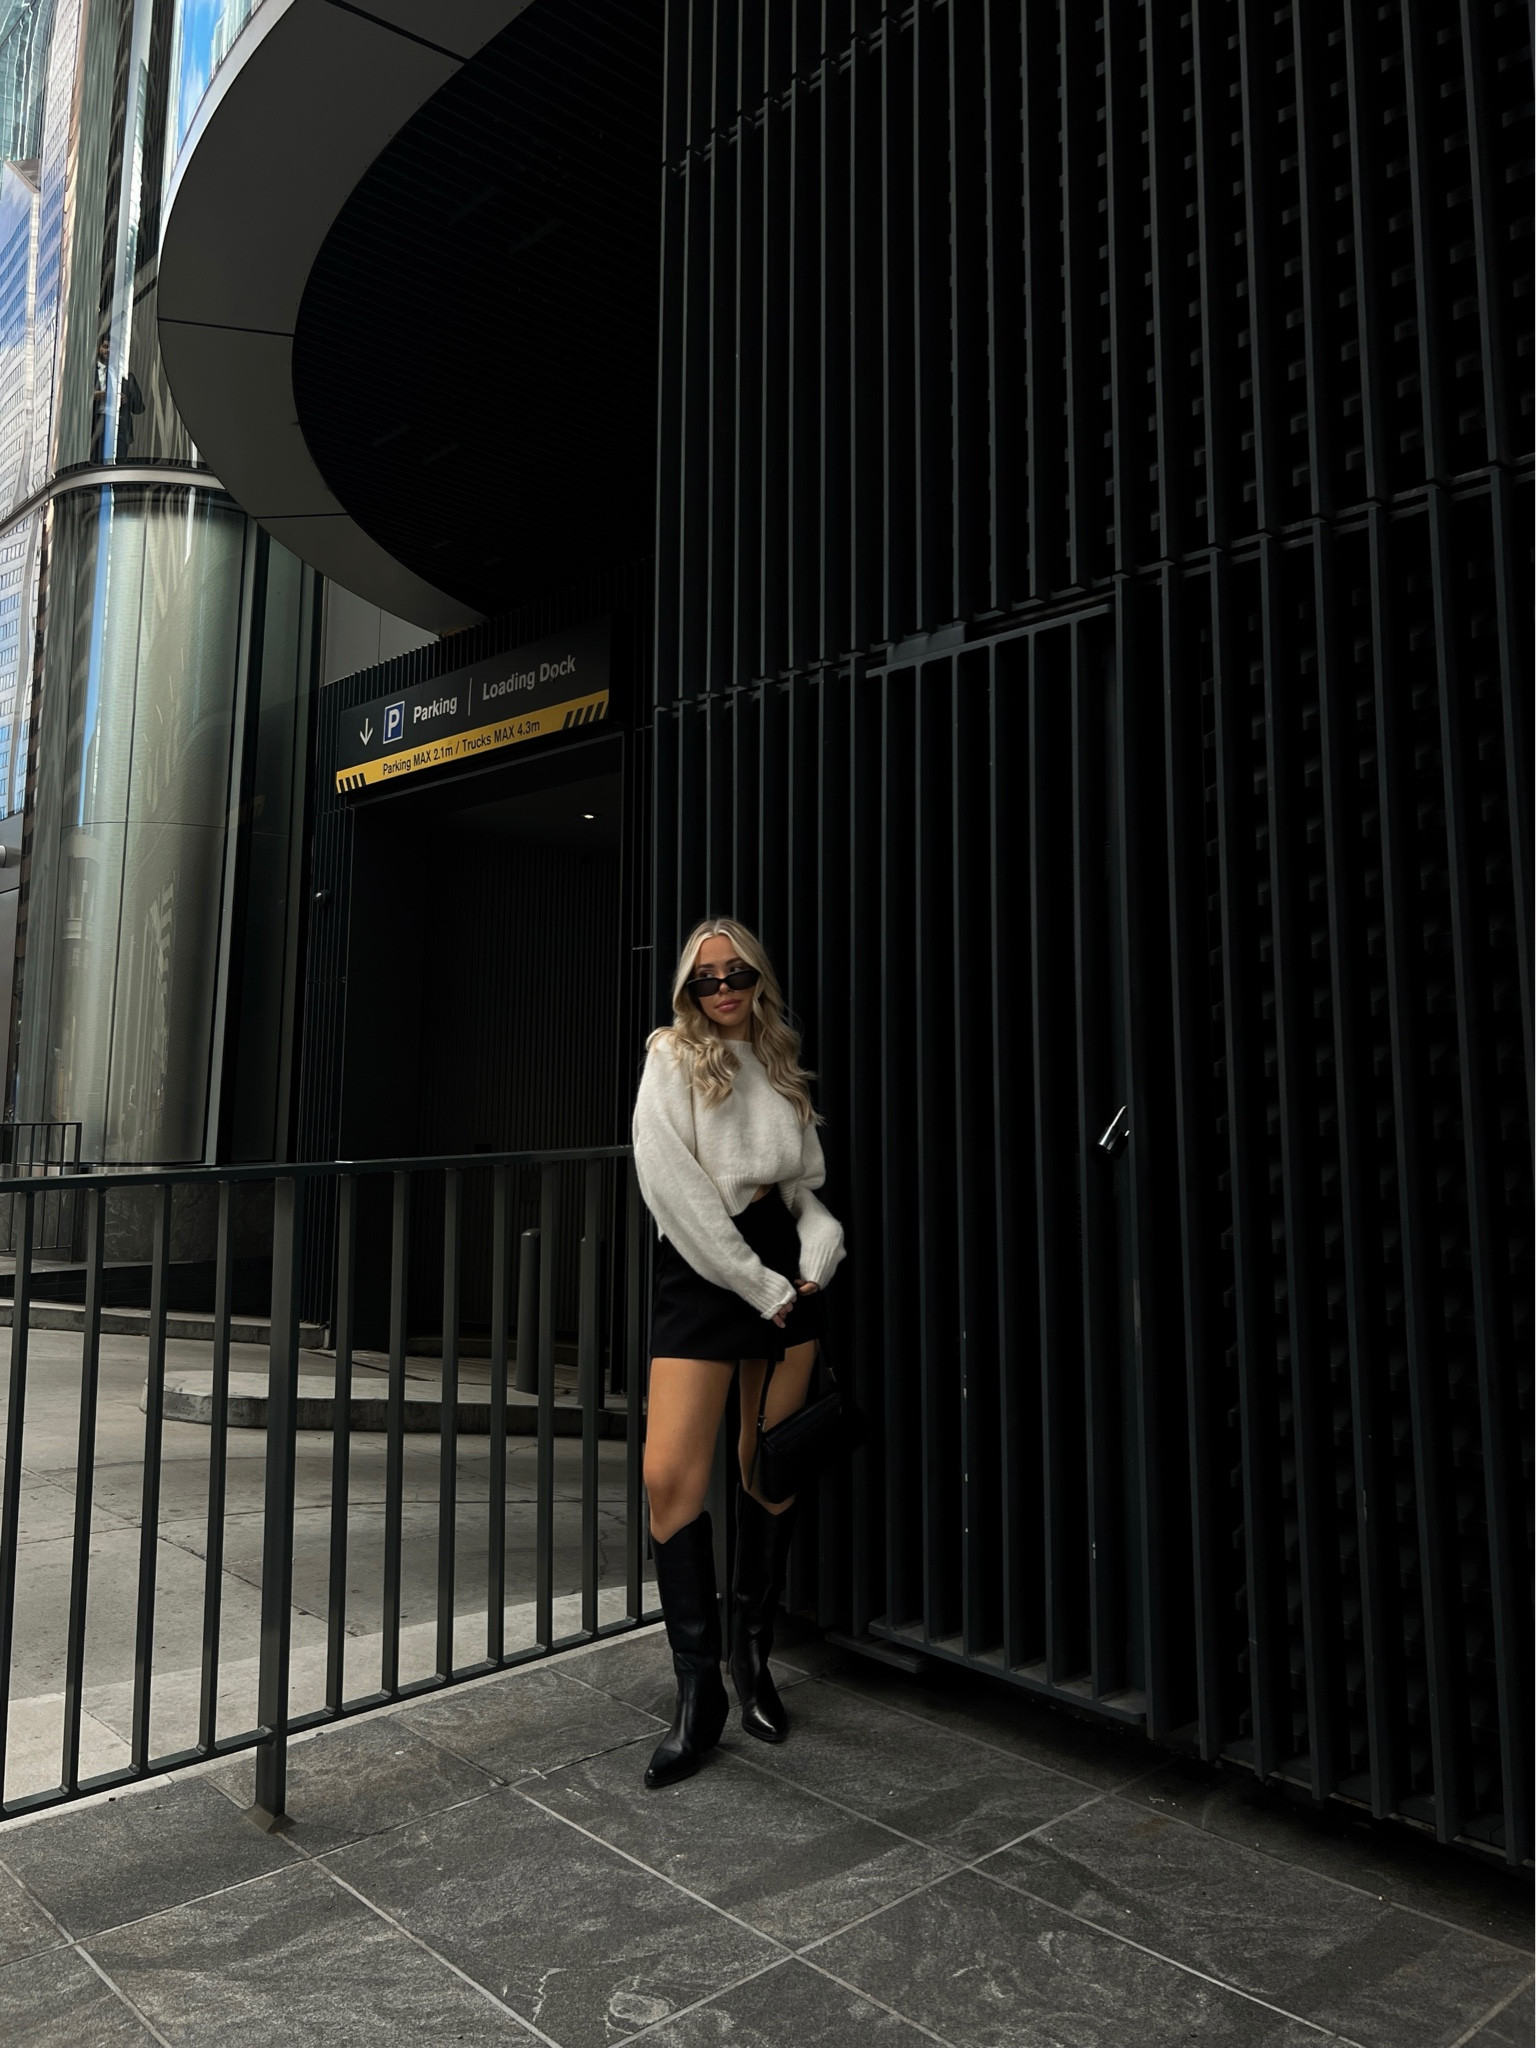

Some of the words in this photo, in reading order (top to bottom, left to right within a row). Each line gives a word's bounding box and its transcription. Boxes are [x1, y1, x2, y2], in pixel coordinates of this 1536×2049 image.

[482, 669, 535, 700] Loading
[540, 655, 576, 680] Dock
[387, 709, 400, 738] P
[413, 697, 457, 723] Parking
[383, 752, 411, 775] Parking
[413, 747, 431, 766] MAX
[433, 745, 453, 761] 2.1m
[462, 734, 491, 753] Trucks
[494, 725, 515, 744] MAX
[516, 721, 540, 736] 4.3m
